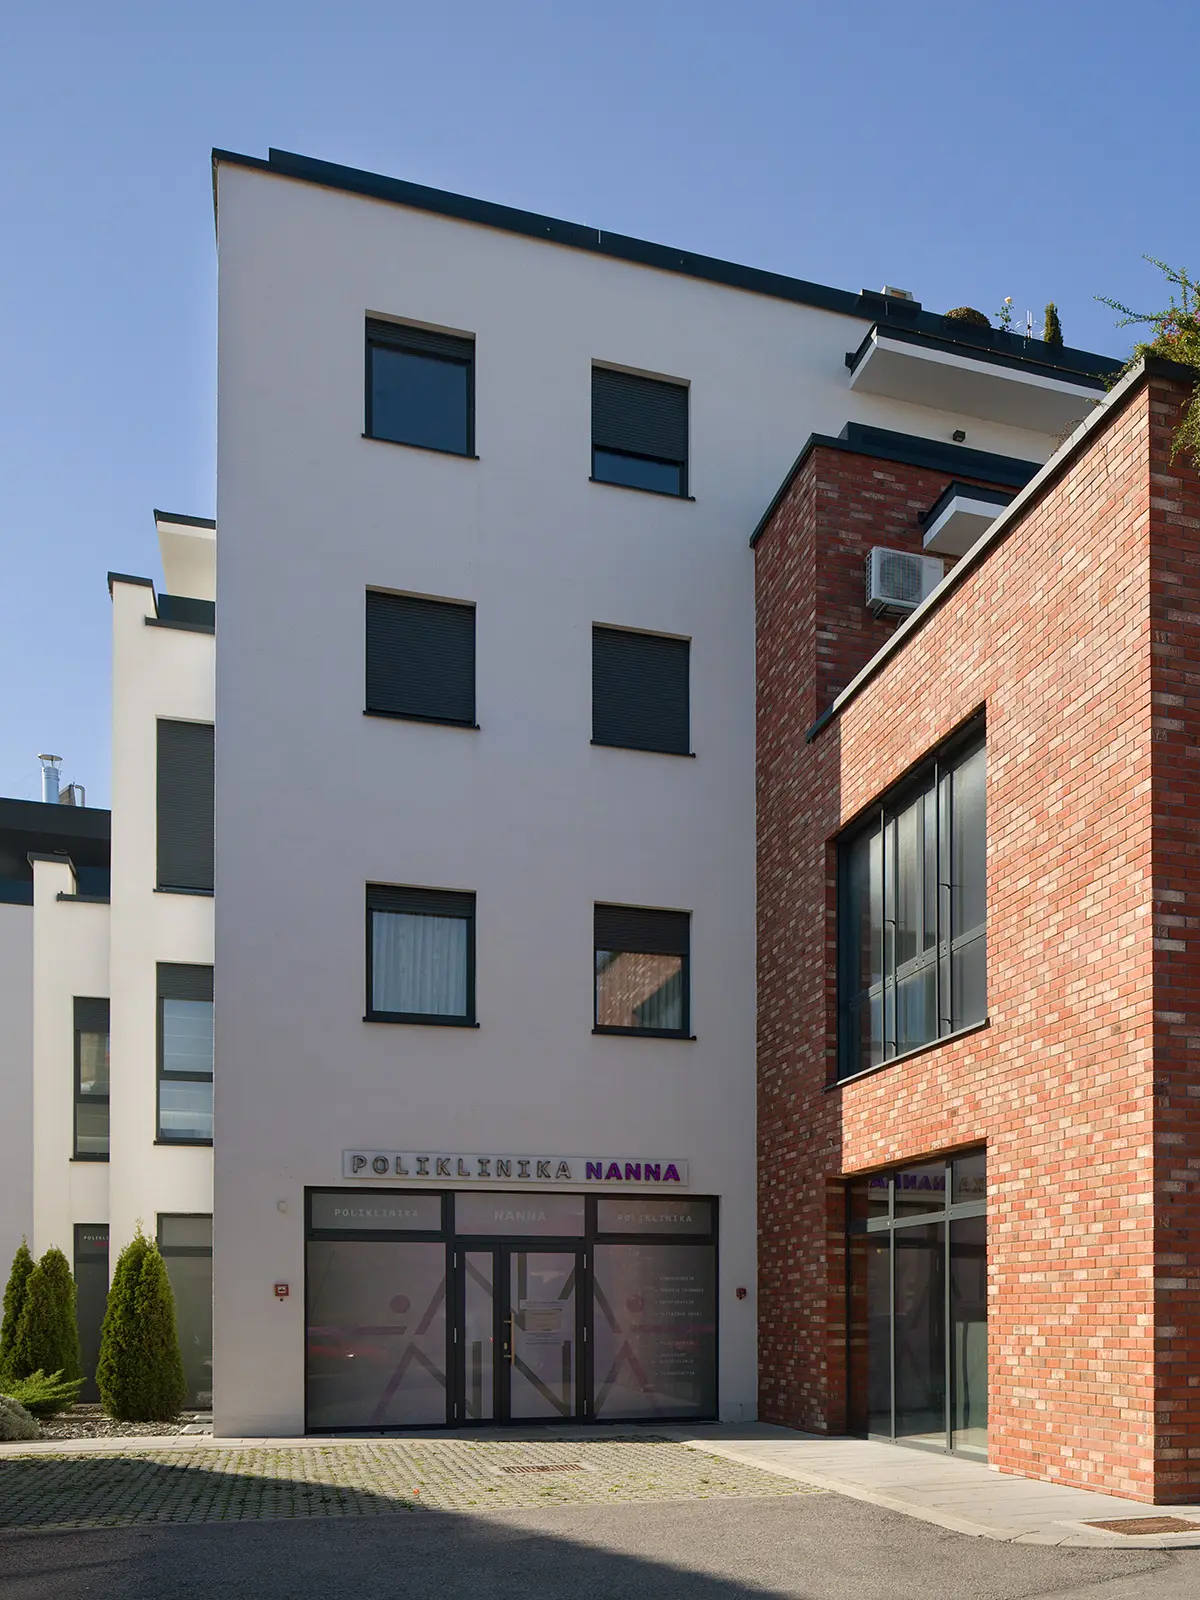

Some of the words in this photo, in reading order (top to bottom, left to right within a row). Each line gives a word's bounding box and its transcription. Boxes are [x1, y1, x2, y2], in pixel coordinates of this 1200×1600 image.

[352, 1155, 572, 1179] POLIKLINIKA
[585, 1161, 681, 1182] NANNA
[334, 1208, 420, 1219] POLIKLINIKA
[494, 1209, 547, 1222] NANNA
[617, 1213, 693, 1224] POLIKLINIKA
